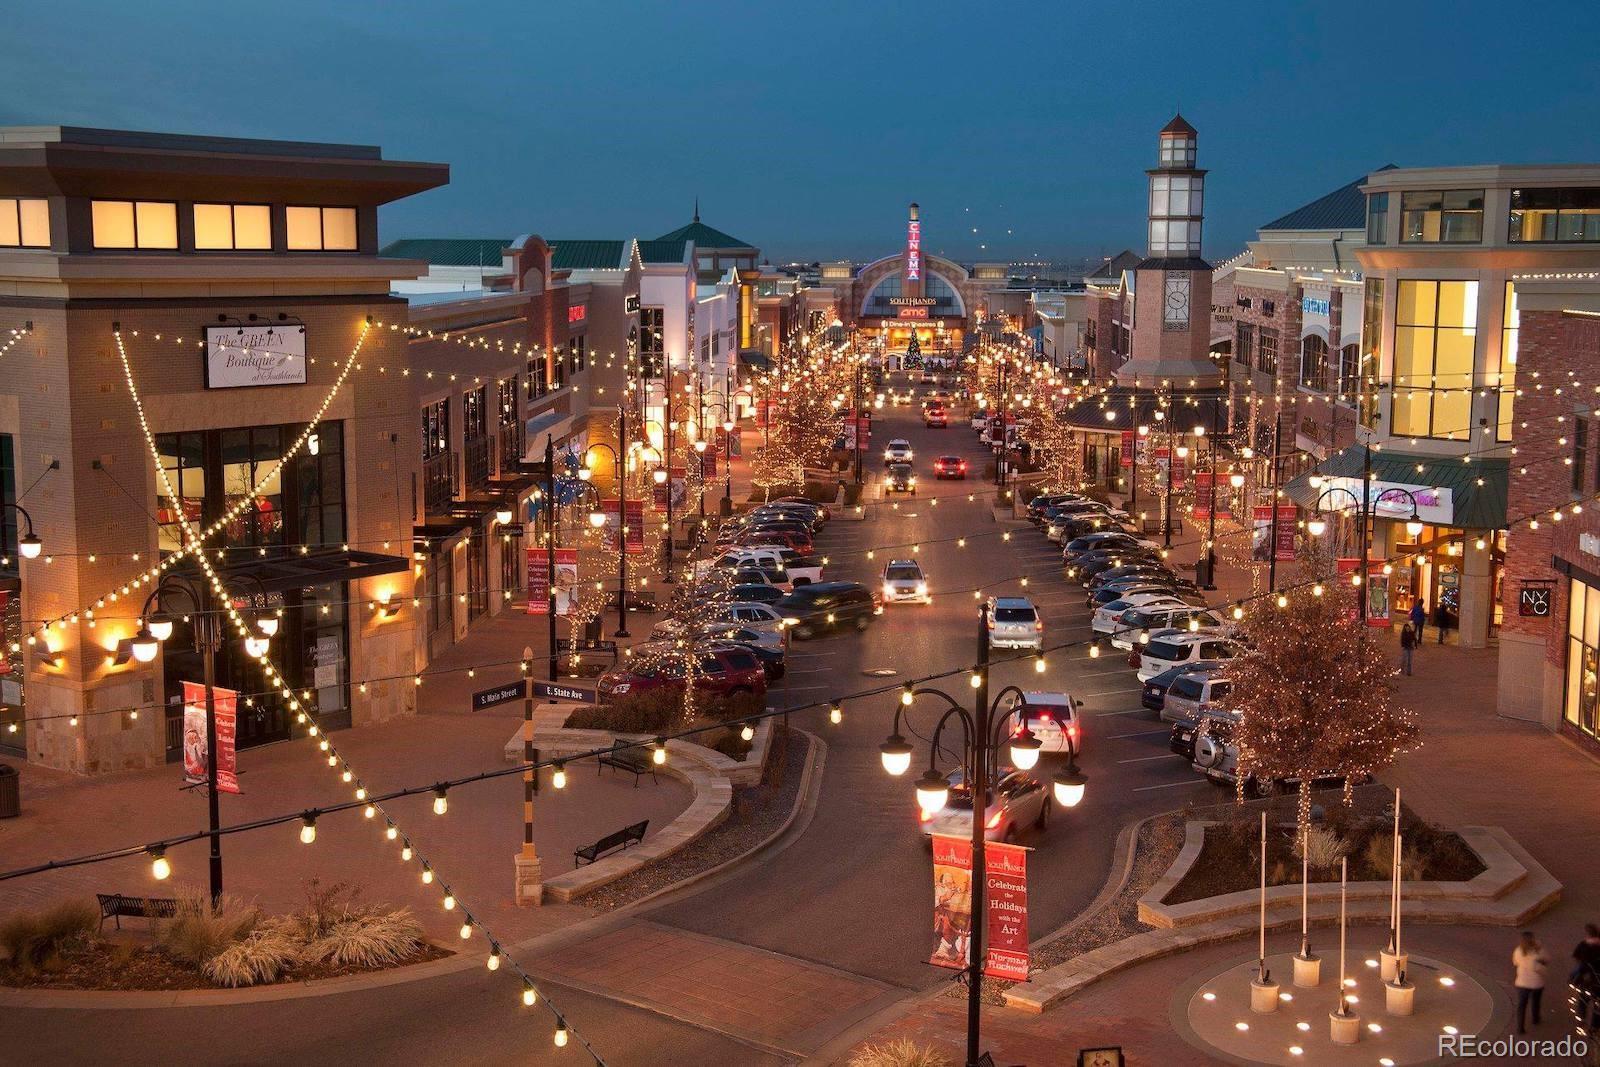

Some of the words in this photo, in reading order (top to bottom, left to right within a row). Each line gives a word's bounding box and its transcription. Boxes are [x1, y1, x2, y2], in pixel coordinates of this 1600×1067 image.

[909, 223, 919, 278] CINEMA
[889, 297, 937, 306] SOUTHLANDS
[216, 334, 237, 347] The
[240, 333, 285, 347] GREEN
[226, 354, 275, 371] Boutique
[481, 696, 488, 704] S.
[488, 693, 501, 702] Main
[501, 688, 517, 699] Street
[547, 686, 553, 695] E.
[554, 687, 570, 698] State
[571, 690, 583, 699] Ave
[990, 899, 1027, 914] Holidays
[1001, 924, 1018, 936] Art
[990, 951, 1027, 965] Norman
